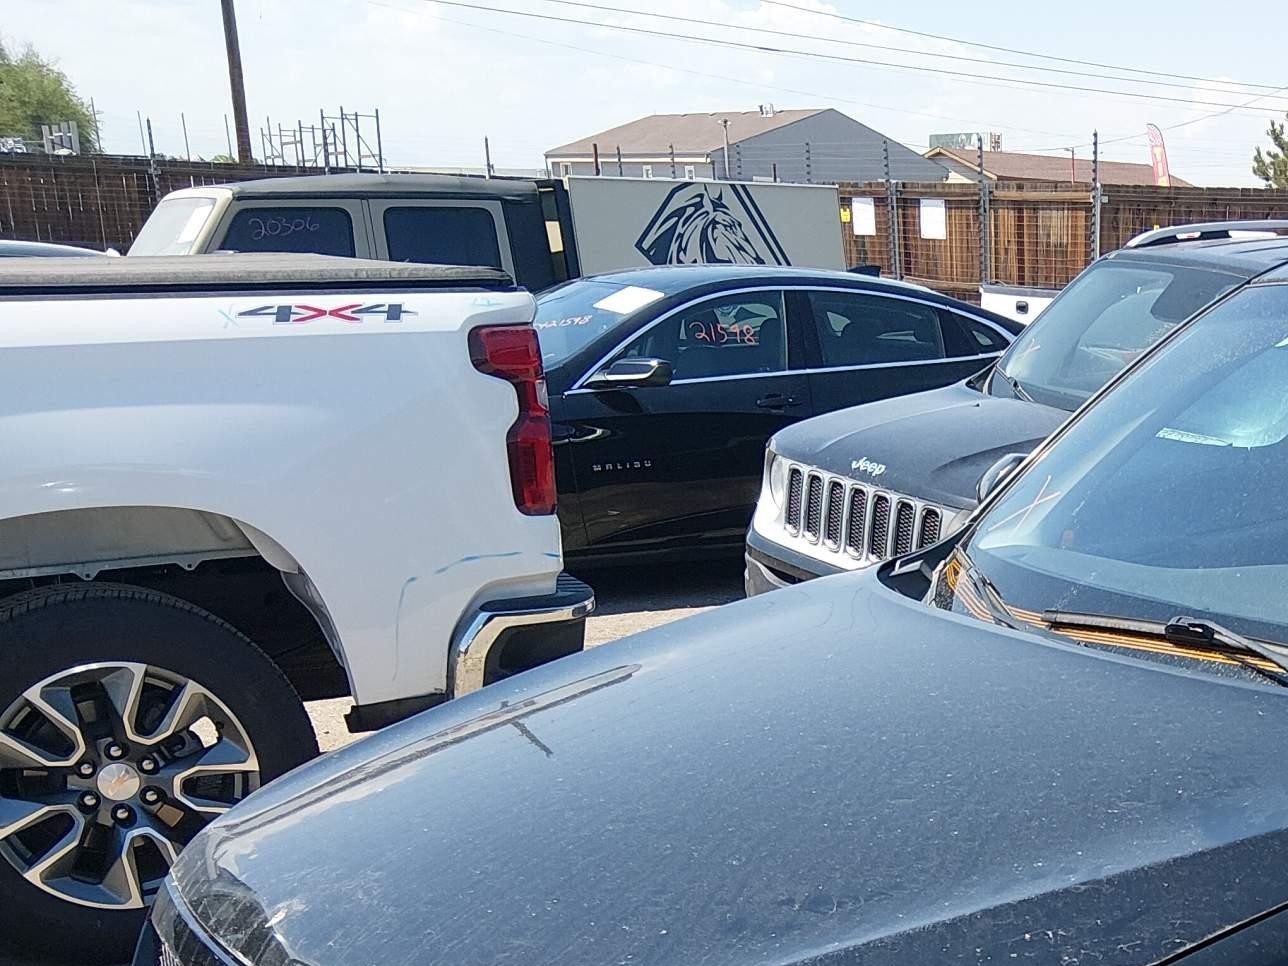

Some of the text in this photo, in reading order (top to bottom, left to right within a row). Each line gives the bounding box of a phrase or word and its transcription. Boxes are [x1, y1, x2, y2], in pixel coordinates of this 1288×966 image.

[247, 216, 320, 240] 20306
[688, 321, 757, 345] 21598
[592, 460, 652, 472] MALIBU
[851, 457, 887, 477] Jeep
